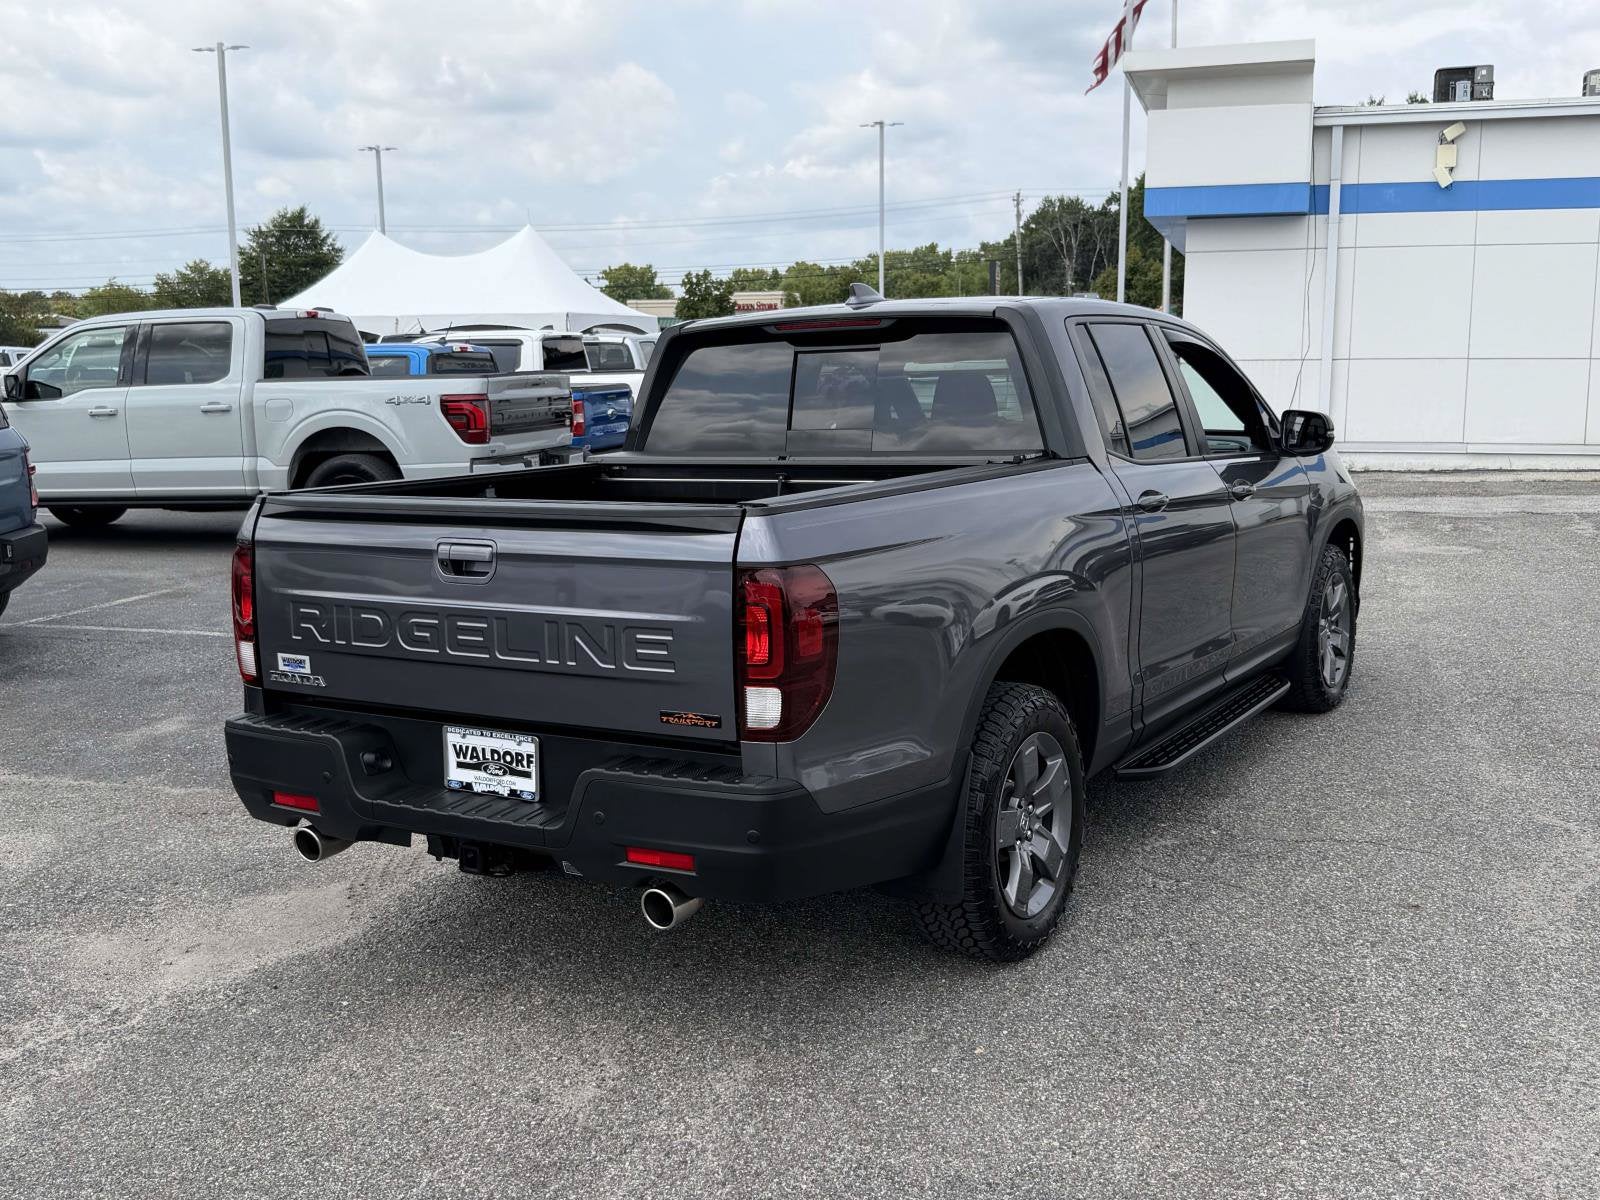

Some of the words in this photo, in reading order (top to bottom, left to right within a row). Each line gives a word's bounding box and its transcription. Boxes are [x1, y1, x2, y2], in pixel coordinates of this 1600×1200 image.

[755, 301, 778, 311] STORE
[289, 600, 676, 673] RIDGELINE
[269, 670, 326, 686] HONDA
[661, 716, 718, 728] TRAILSPORT
[447, 727, 481, 736] DEDICATED
[492, 732, 533, 742] EXCELLENCE
[452, 744, 535, 769] WALDORF
[486, 763, 504, 776] Ford
